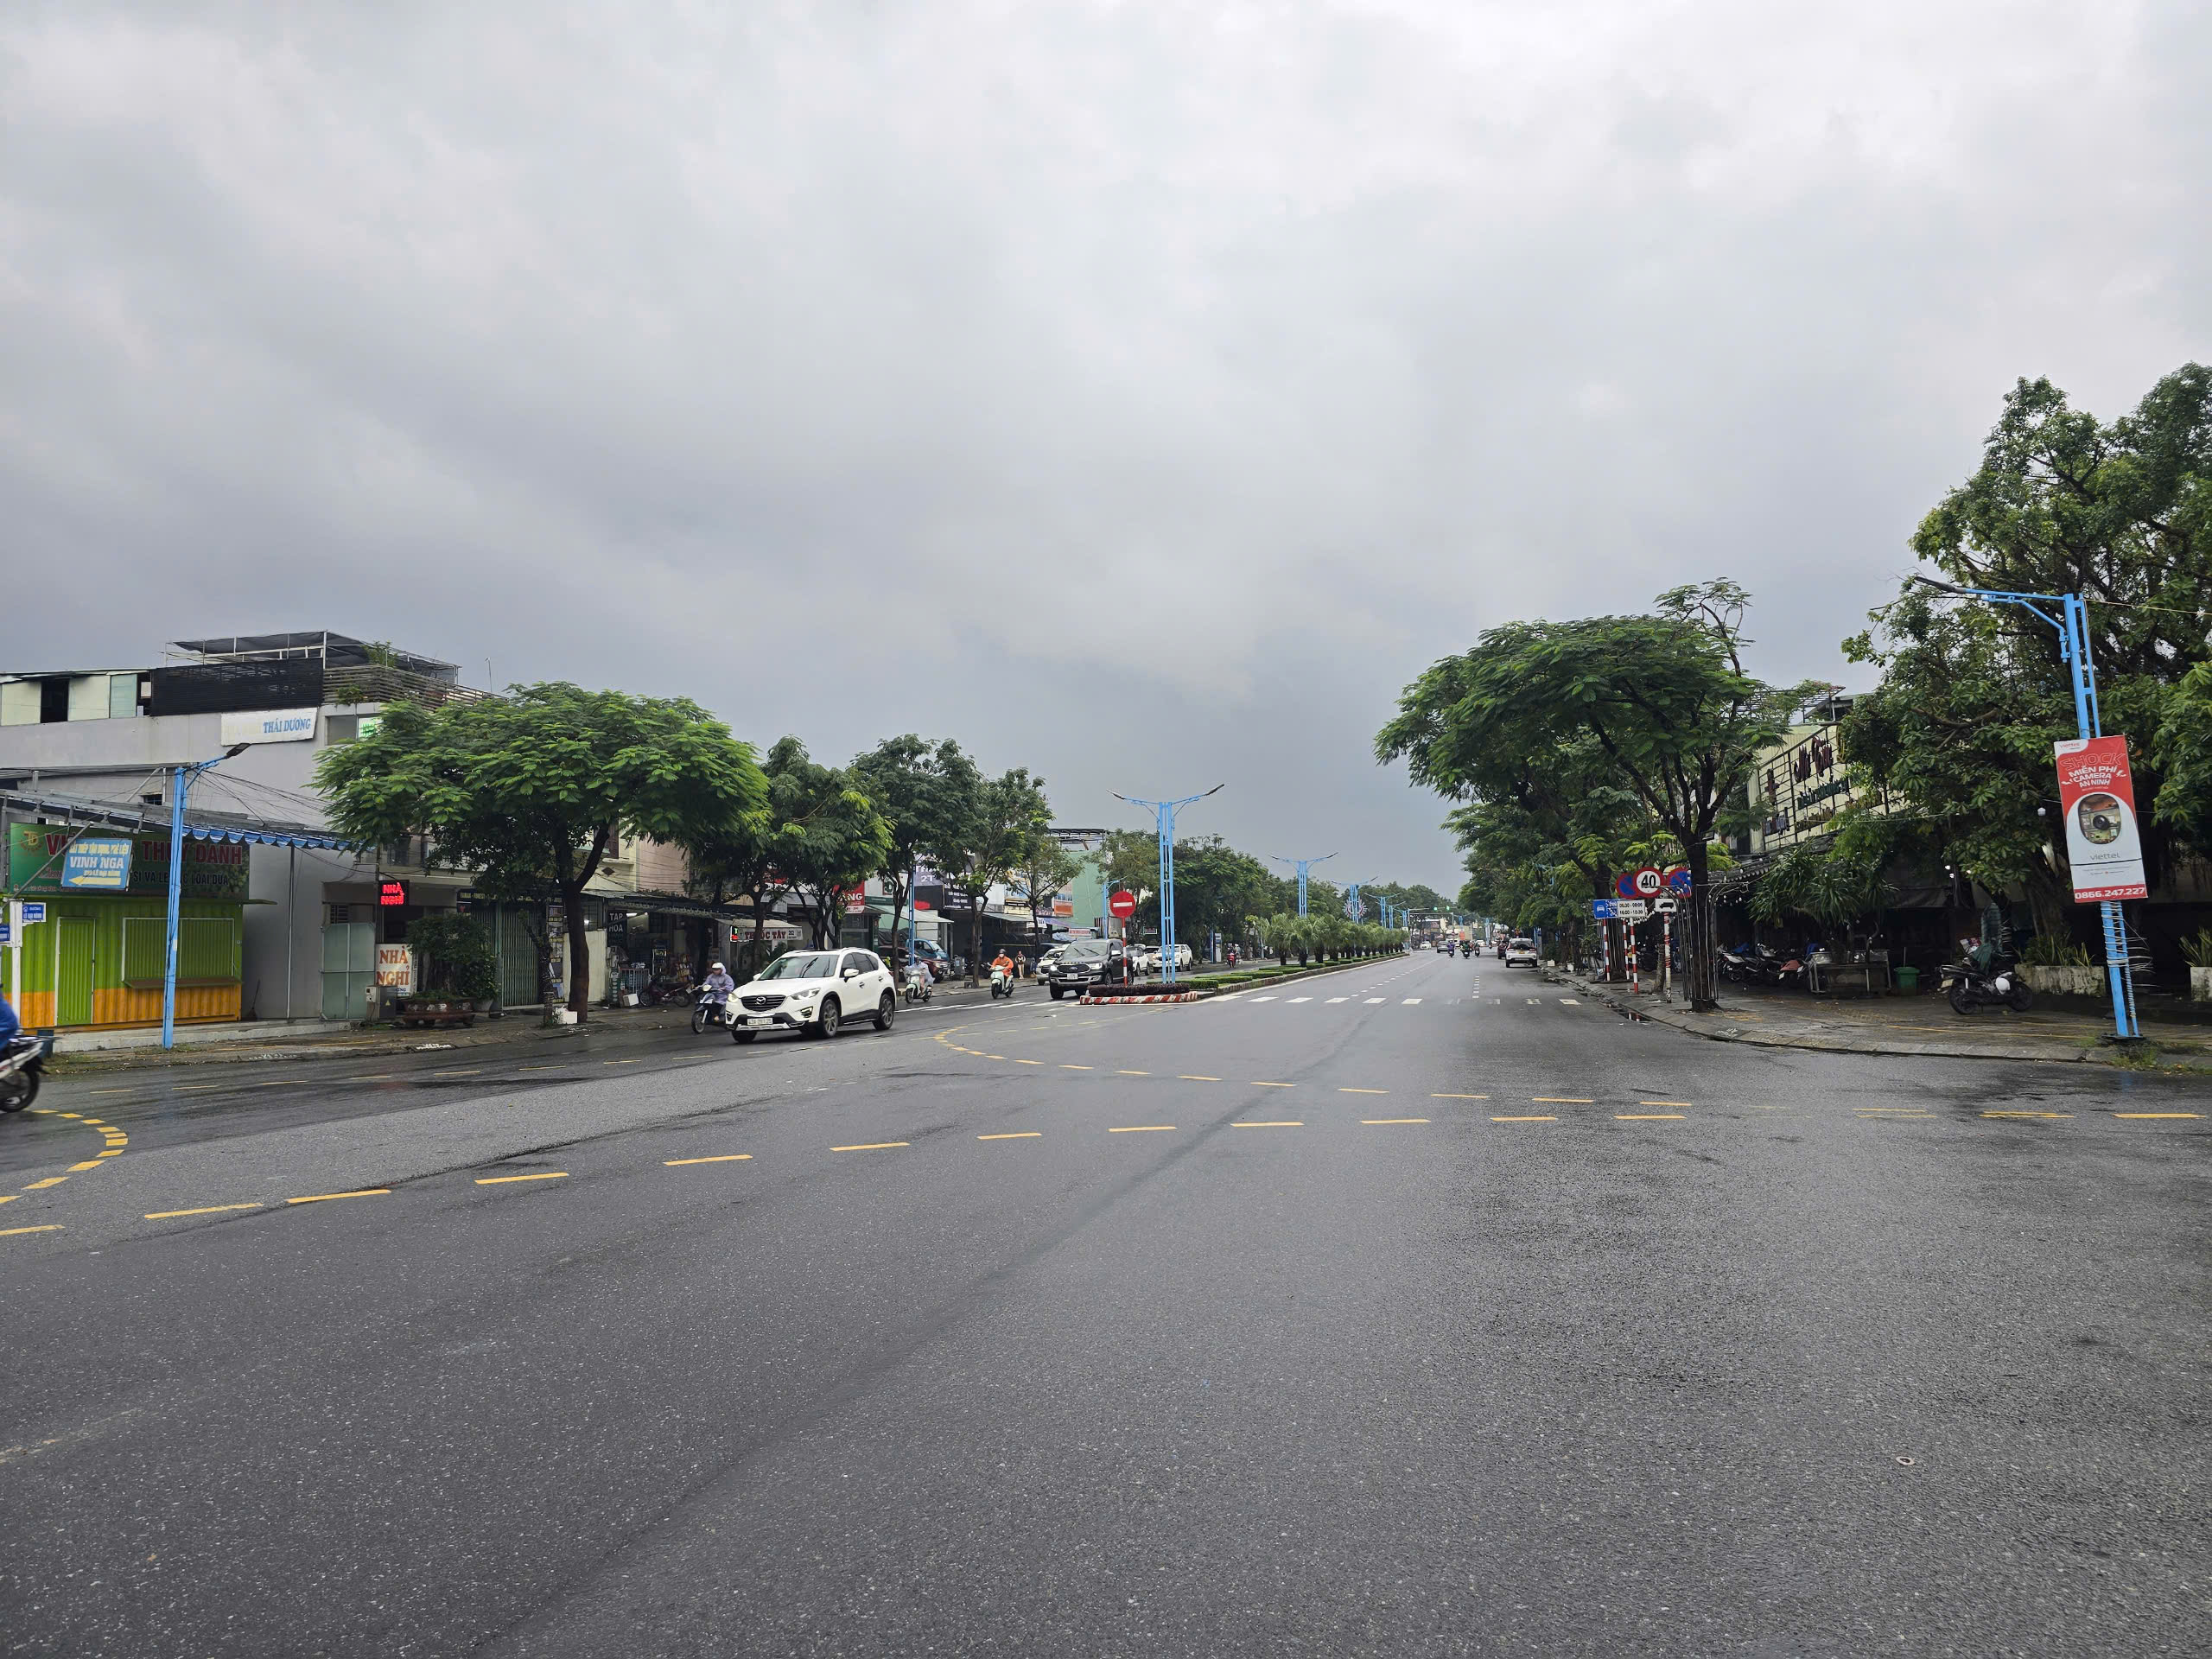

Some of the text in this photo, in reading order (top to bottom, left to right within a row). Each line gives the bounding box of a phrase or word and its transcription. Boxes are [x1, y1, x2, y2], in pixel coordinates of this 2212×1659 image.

[264, 718, 283, 734] THÁI
[2060, 753, 2126, 771] SHOCK
[2098, 765, 2118, 773] PHÍ
[2073, 772, 2112, 783] CAMERA
[195, 842, 242, 865] DANH
[2089, 851, 2121, 861] viettel
[70, 856, 124, 869] VINH NGA
[1642, 874, 1656, 888] 40
[772, 931, 786, 939] TÂY
[379, 945, 409, 964] NHÀ
[377, 964, 410, 986] NGHỈ
